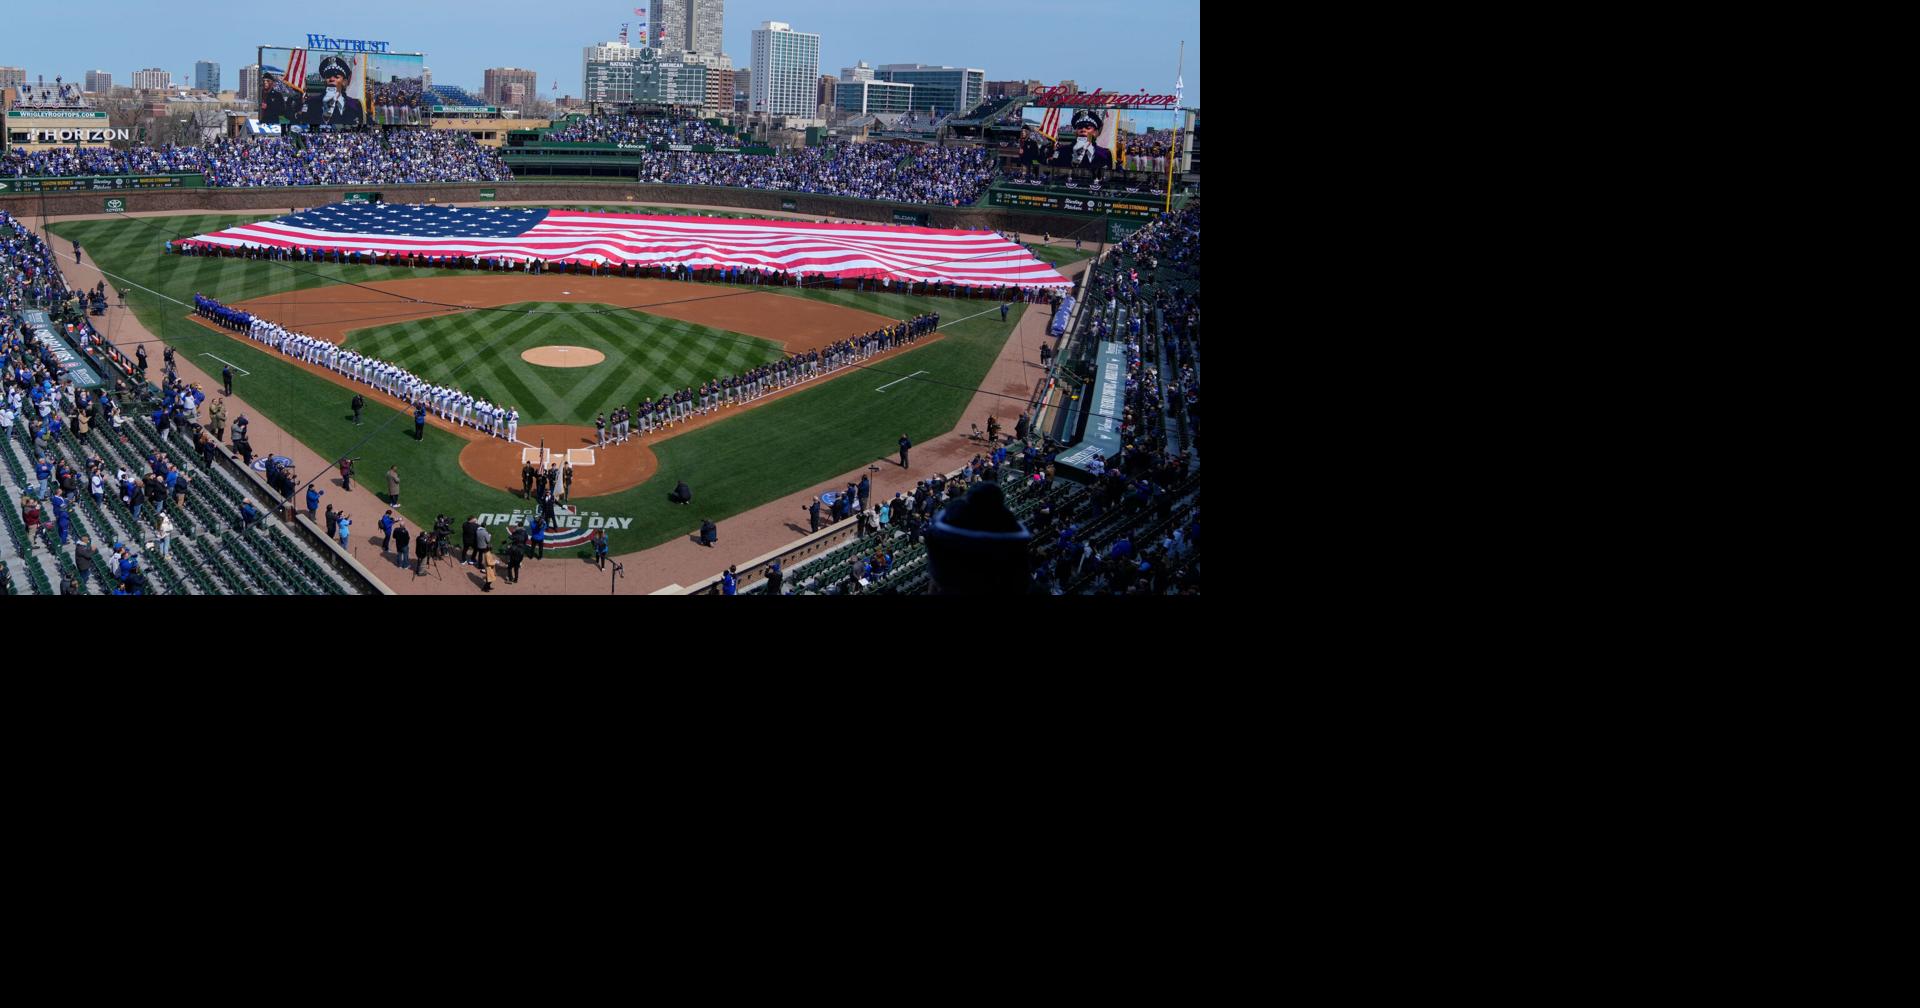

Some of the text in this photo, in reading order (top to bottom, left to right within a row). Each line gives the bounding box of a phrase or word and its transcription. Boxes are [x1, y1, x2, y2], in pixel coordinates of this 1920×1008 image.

[306, 34, 389, 53] WINTRUST
[1034, 85, 1178, 106] Budweiser
[44, 128, 130, 141] HORIZON
[478, 513, 633, 529] OPENG DAY
